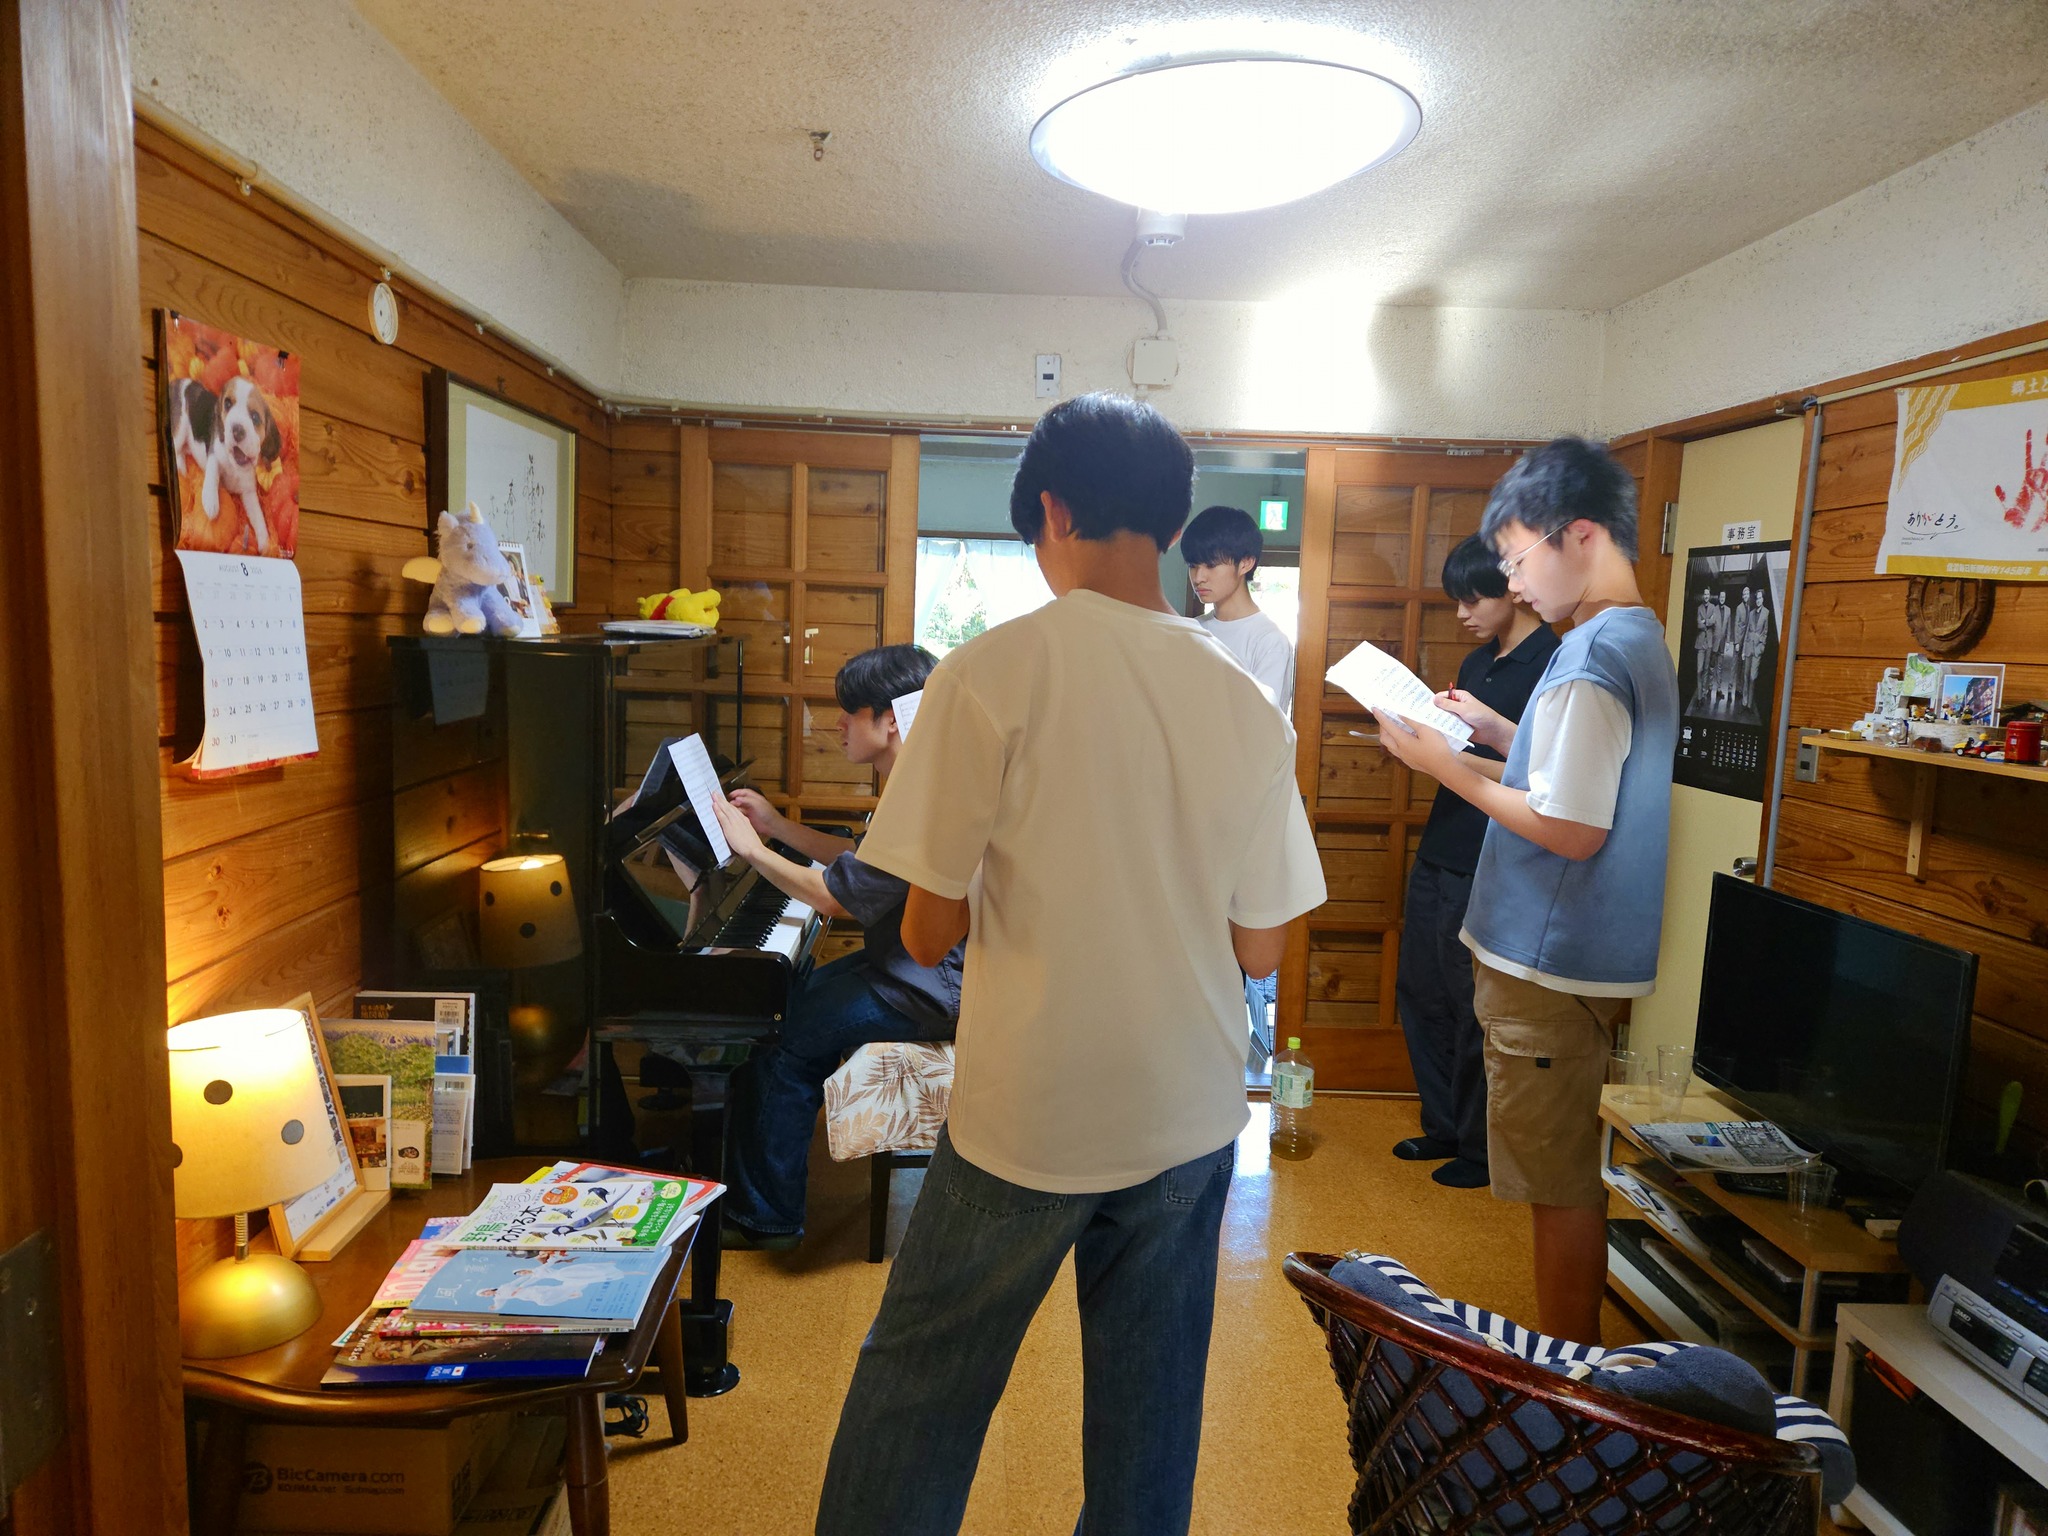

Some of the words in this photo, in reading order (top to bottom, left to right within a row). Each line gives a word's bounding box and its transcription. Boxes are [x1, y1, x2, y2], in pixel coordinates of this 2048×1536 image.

[1727, 525, 1756, 541] 事務室
[240, 562, 249, 577] 8
[209, 648, 214, 658] 9
[224, 648, 232, 658] 10
[240, 647, 247, 657] 11
[254, 647, 261, 657] 12
[268, 647, 275, 656] 13
[282, 647, 288, 656] 14
[295, 646, 301, 655] 15
[211, 679, 219, 688] 16
[227, 677, 234, 687] 17
[243, 676, 250, 685] 18
[257, 675, 264, 684] 19
[271, 674, 278, 683] 20
[285, 673, 291, 682] 21
[297, 672, 304, 681] 22
[212, 707, 220, 717] 23
[229, 706, 236, 716] 24
[245, 704, 252, 714] 25
[260, 703, 267, 713] 26
[273, 701, 280, 711] 27
[287, 699, 294, 709] 28
[300, 698, 306, 707] 29
[212, 736, 220, 747] 30
[230, 734, 237, 745] 31
[1702, 728, 1707, 738] 8
[492, 1205, 546, 1243] わかる本
[348, 1333, 371, 1362] OTSUKA
[277, 1467, 405, 1483] BicCamera.com
